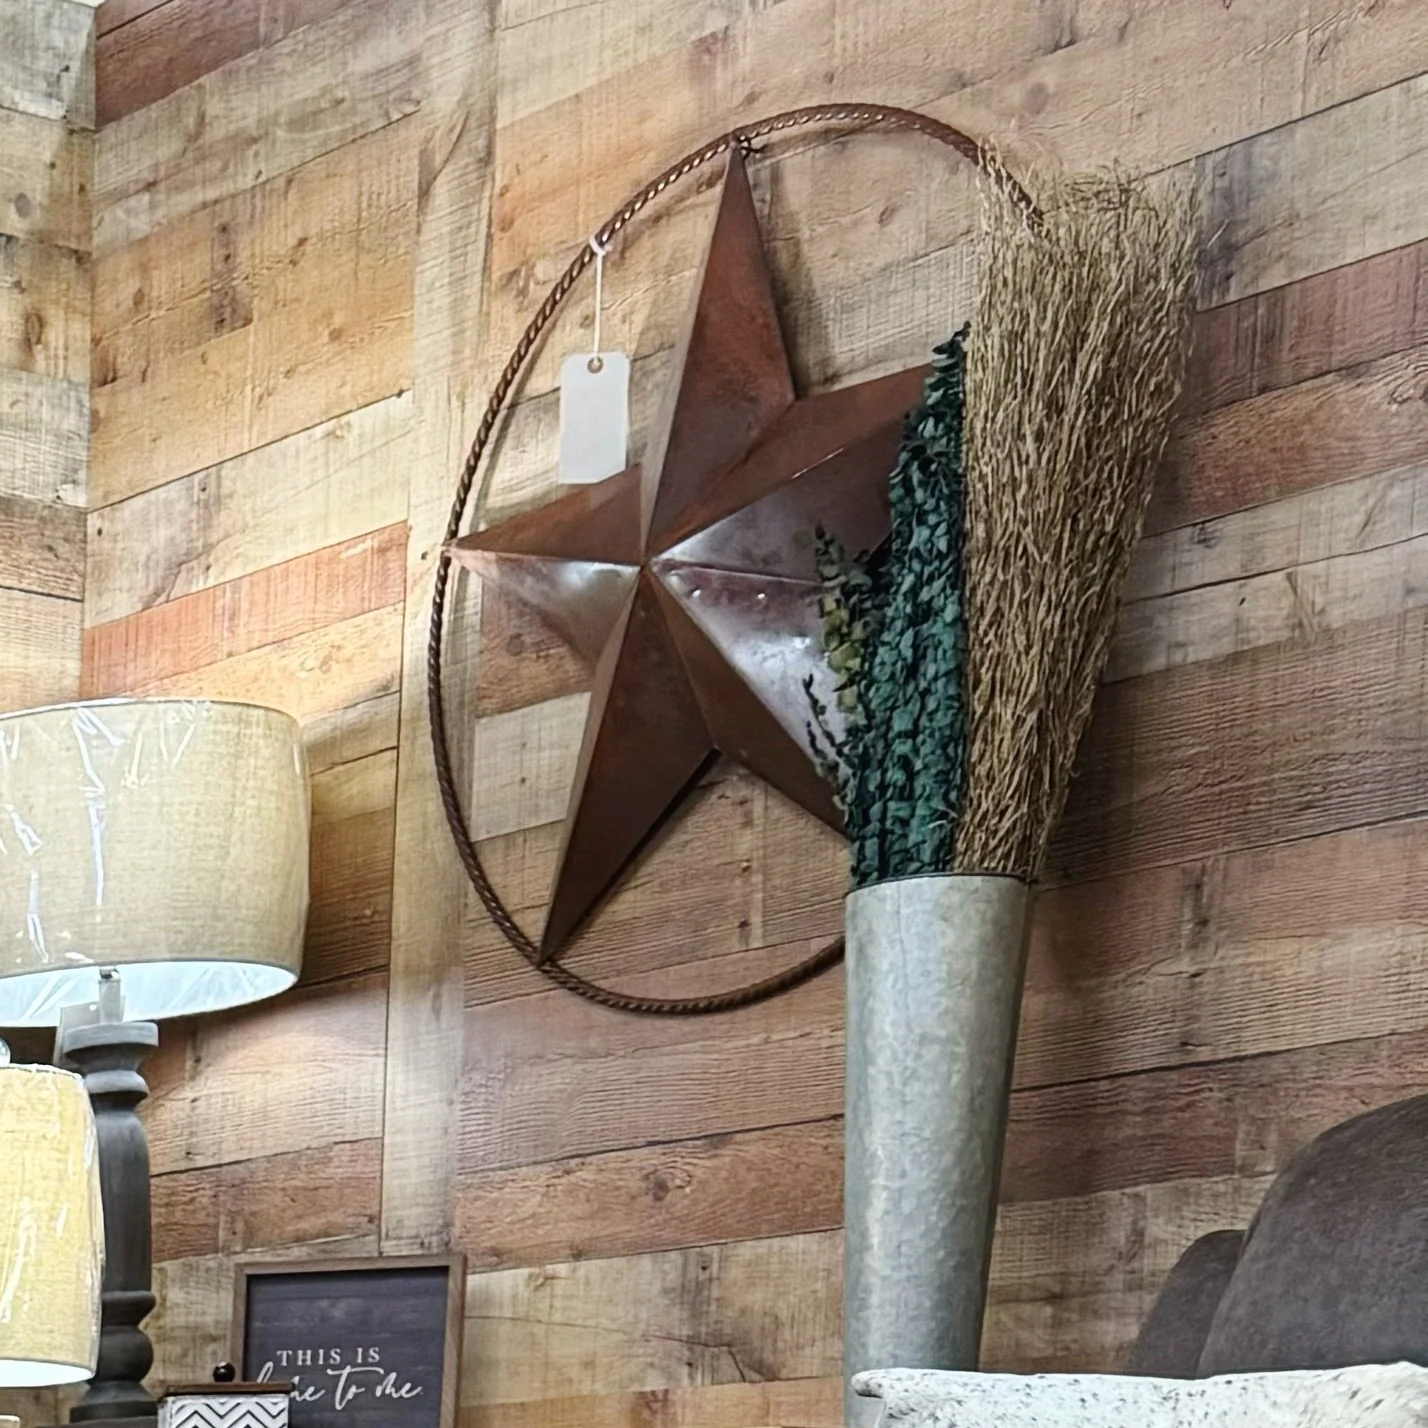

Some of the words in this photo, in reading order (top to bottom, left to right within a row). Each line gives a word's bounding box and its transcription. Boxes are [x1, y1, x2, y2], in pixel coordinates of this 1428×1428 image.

[276, 1348, 341, 1366] THIS
[356, 1346, 380, 1363] IS
[326, 1365, 384, 1411] to
